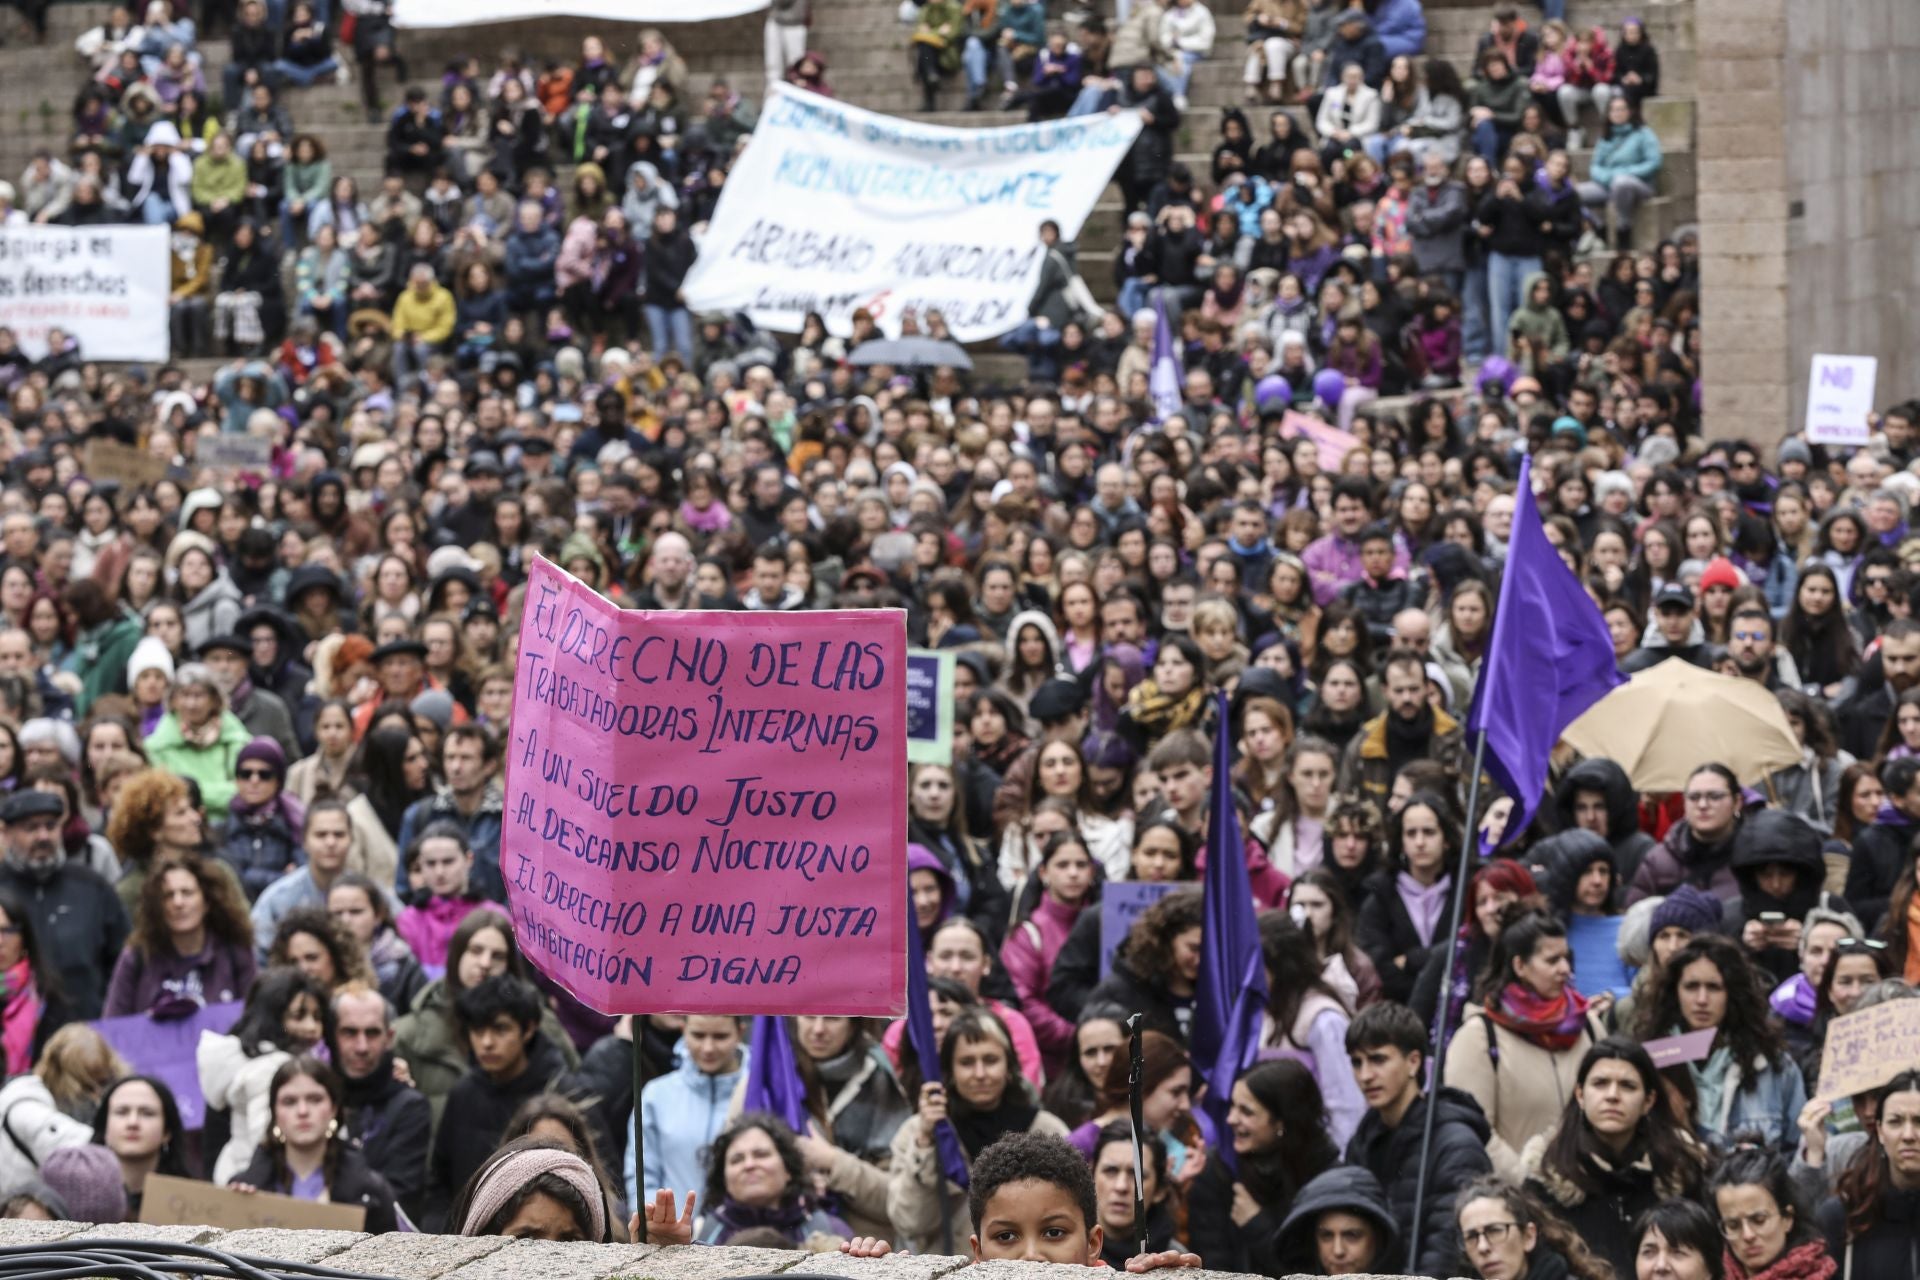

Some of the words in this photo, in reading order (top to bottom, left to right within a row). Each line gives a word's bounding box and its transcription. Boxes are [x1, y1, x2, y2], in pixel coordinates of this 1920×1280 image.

[1820, 364, 1854, 390] NO
[533, 583, 558, 644] EL
[558, 607, 728, 687] DERECHO
[745, 641, 803, 688] DE
[810, 640, 886, 692] LAS
[525, 652, 699, 742] TRABAJADORAS
[698, 686, 880, 762] INTERNAS
[541, 747, 572, 789] UN
[577, 768, 699, 819] SUELDO
[704, 776, 837, 827] JUSTO
[540, 807, 680, 873] DESCANSO
[690, 828, 871, 883] NOCTURNO
[543, 871, 648, 937] DERECHO
[658, 902, 683, 937] A
[691, 901, 756, 937] UNA
[766, 906, 878, 938] JUSTA
[522, 905, 653, 987] HABITACIÓN
[676, 951, 802, 985] DIGNA
